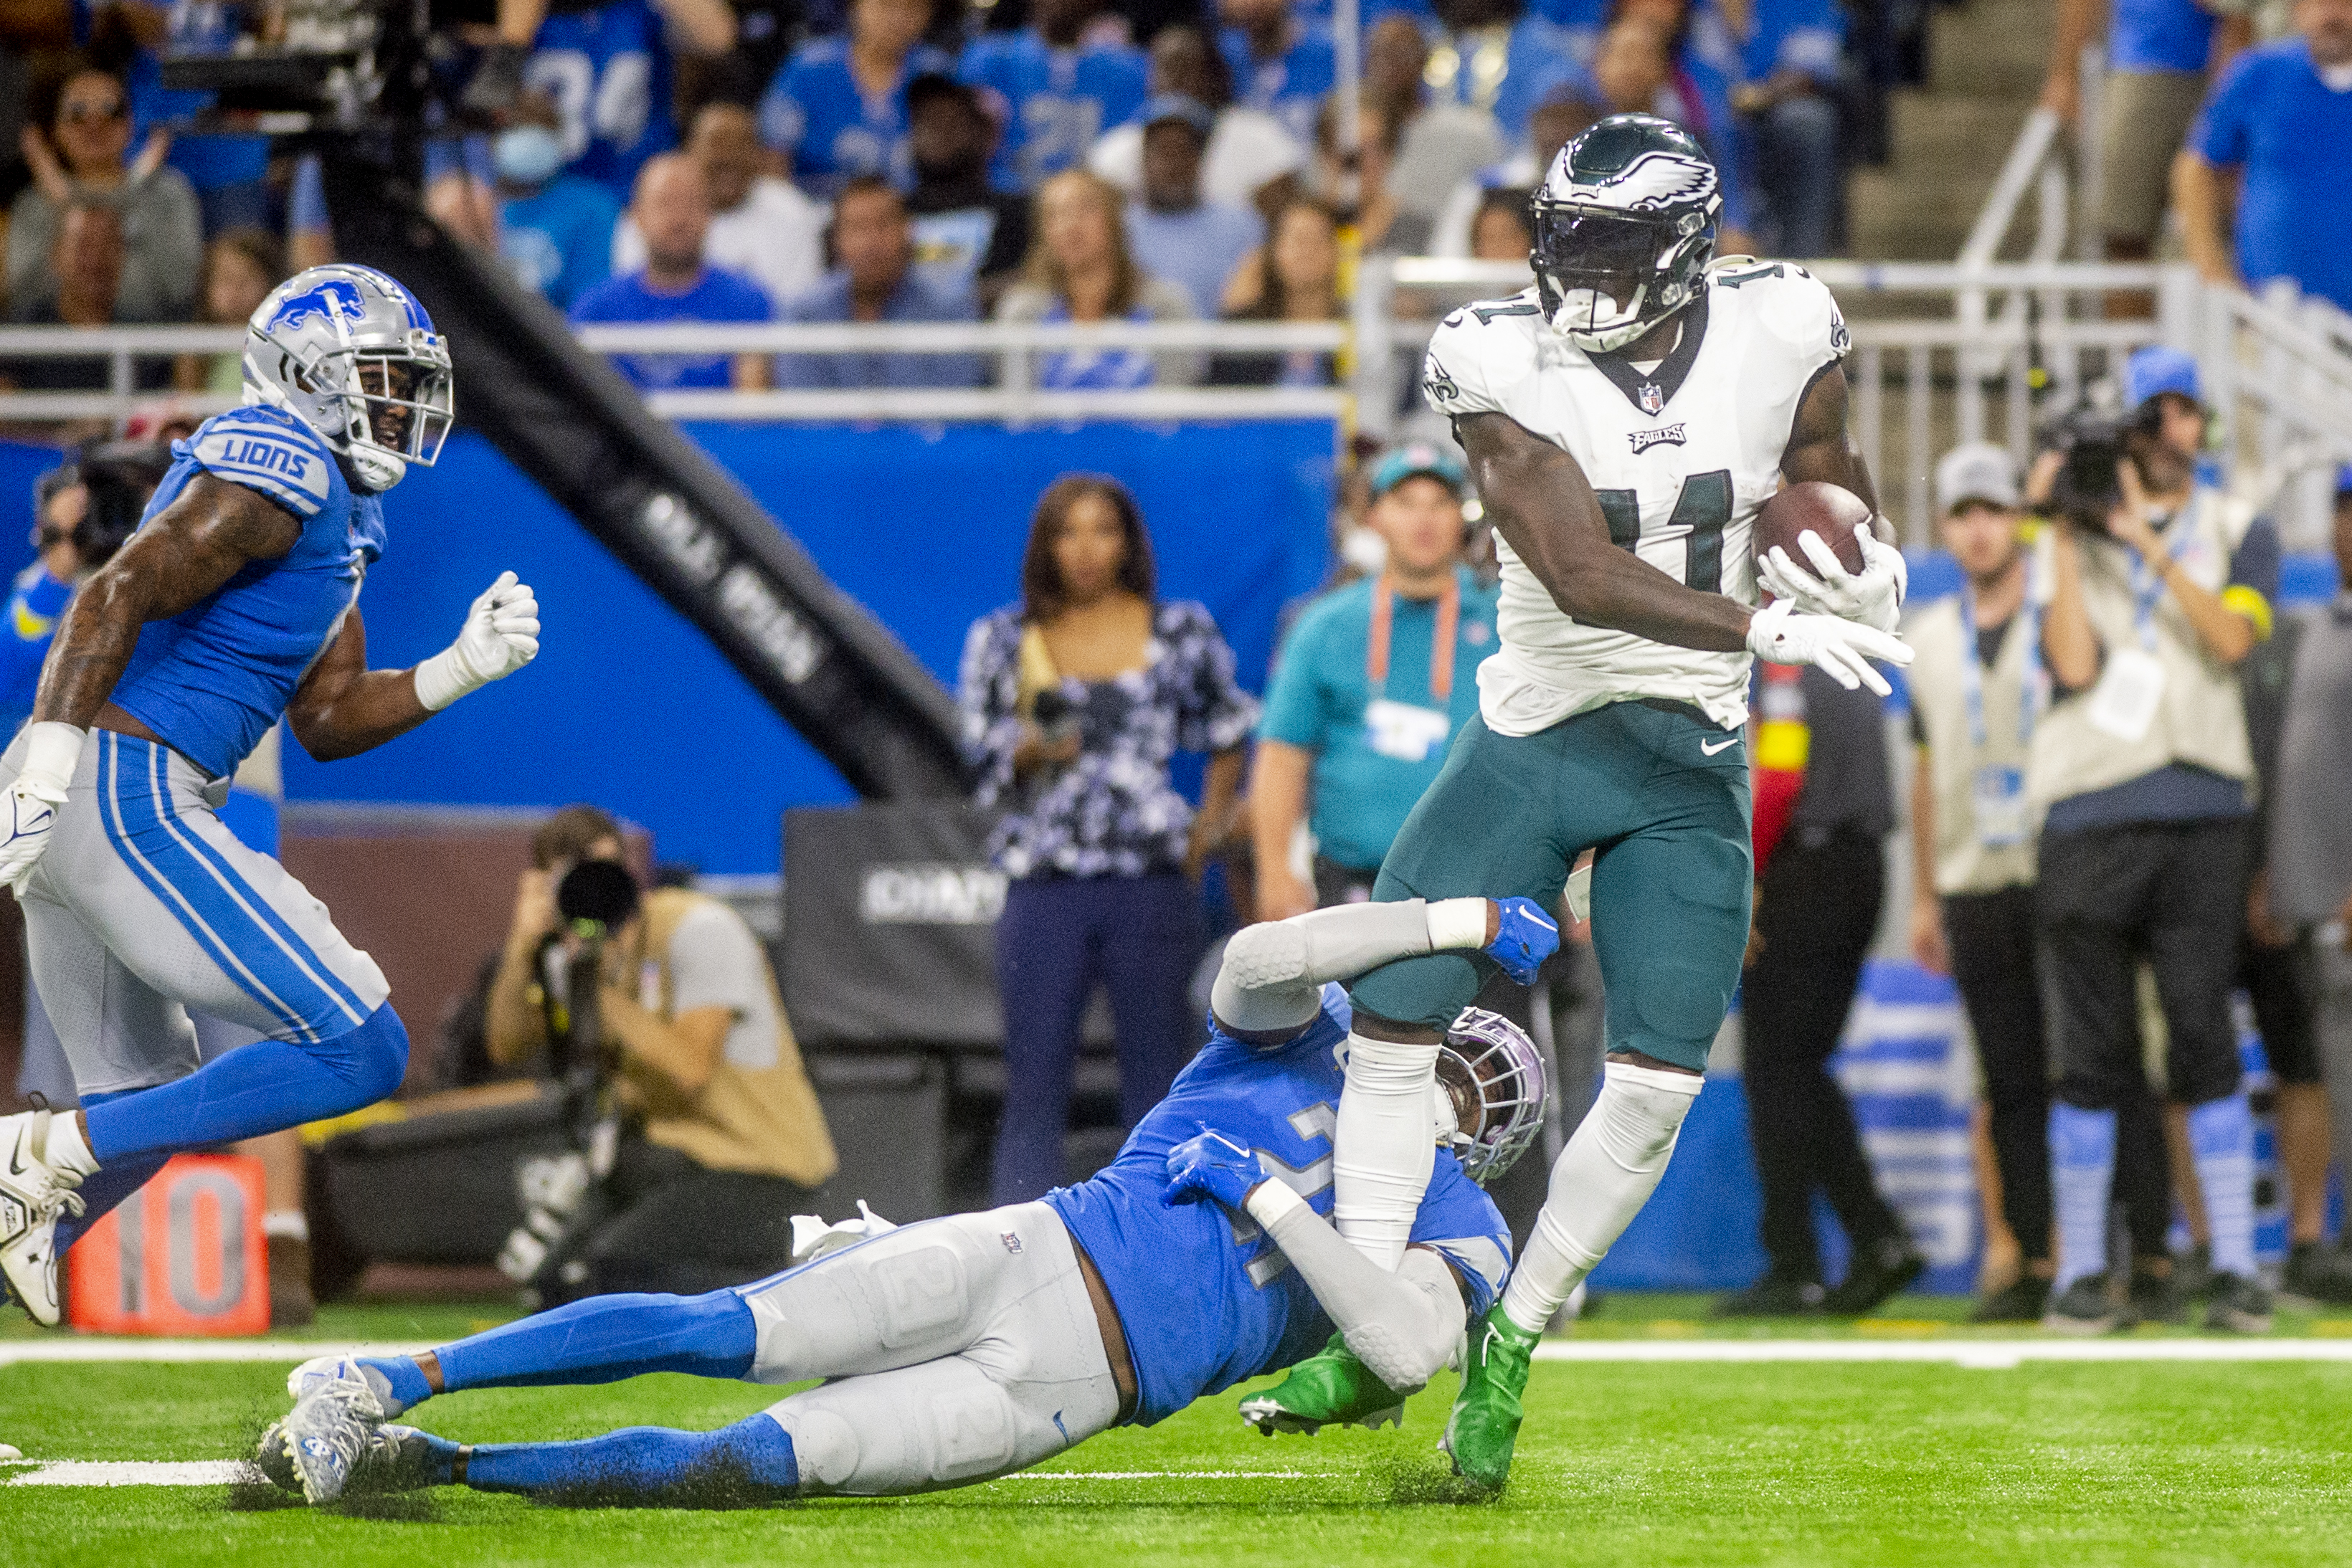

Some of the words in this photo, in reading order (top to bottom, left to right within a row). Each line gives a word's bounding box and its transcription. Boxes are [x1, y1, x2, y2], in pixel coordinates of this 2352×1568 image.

[1626, 422, 1687, 455] EAGLES
[220, 439, 310, 480] LIONS
[116, 1172, 245, 1318] 10
